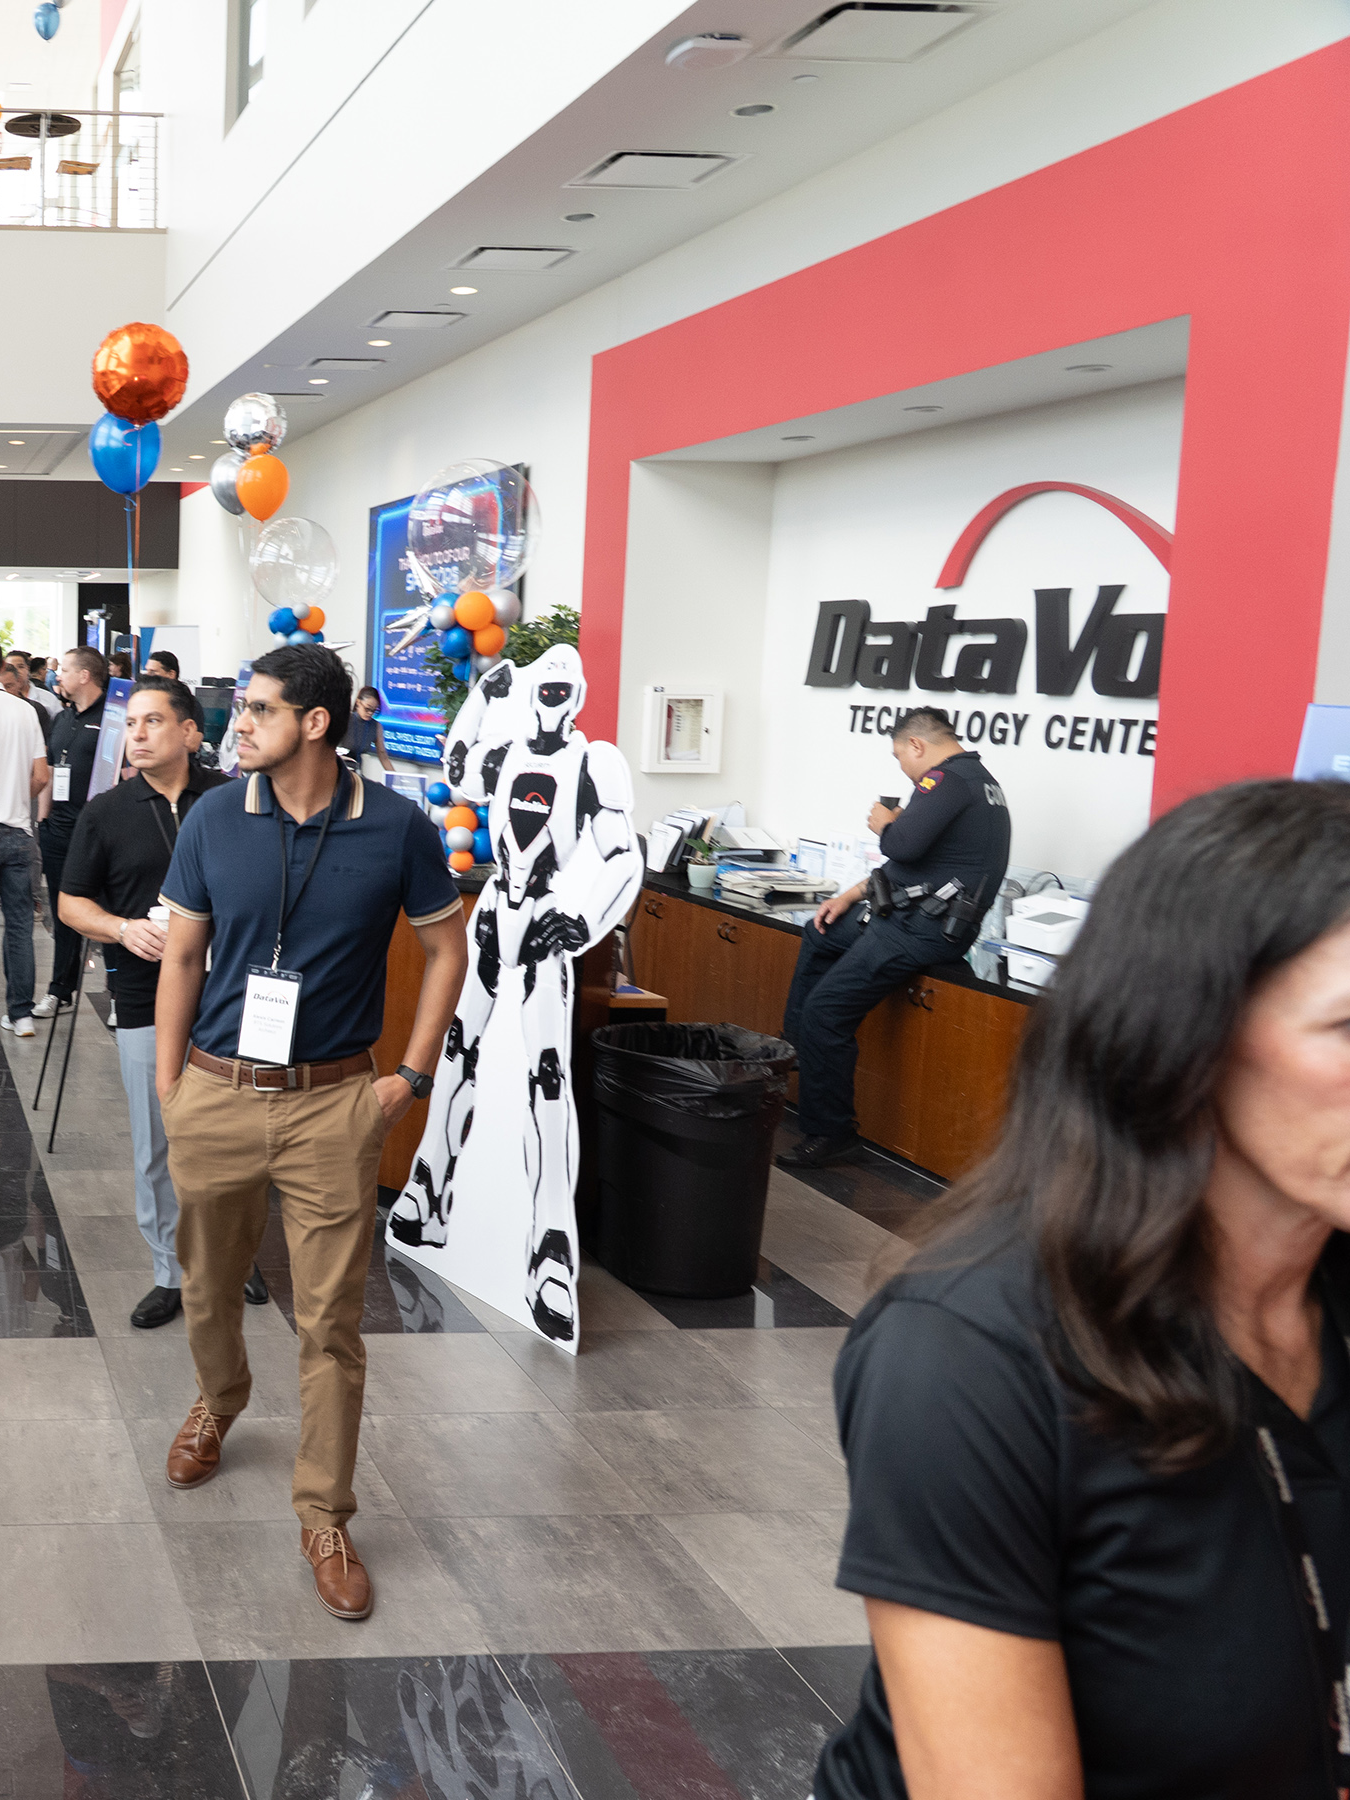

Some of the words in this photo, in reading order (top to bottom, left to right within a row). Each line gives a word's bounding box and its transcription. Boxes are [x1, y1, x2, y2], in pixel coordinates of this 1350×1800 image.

[804, 585, 1167, 698] DataVo
[849, 704, 1029, 746] TECHLOGY
[1045, 714, 1159, 757] CENTE
[510, 797, 551, 815] DataVox
[253, 992, 289, 1006] DataVox
